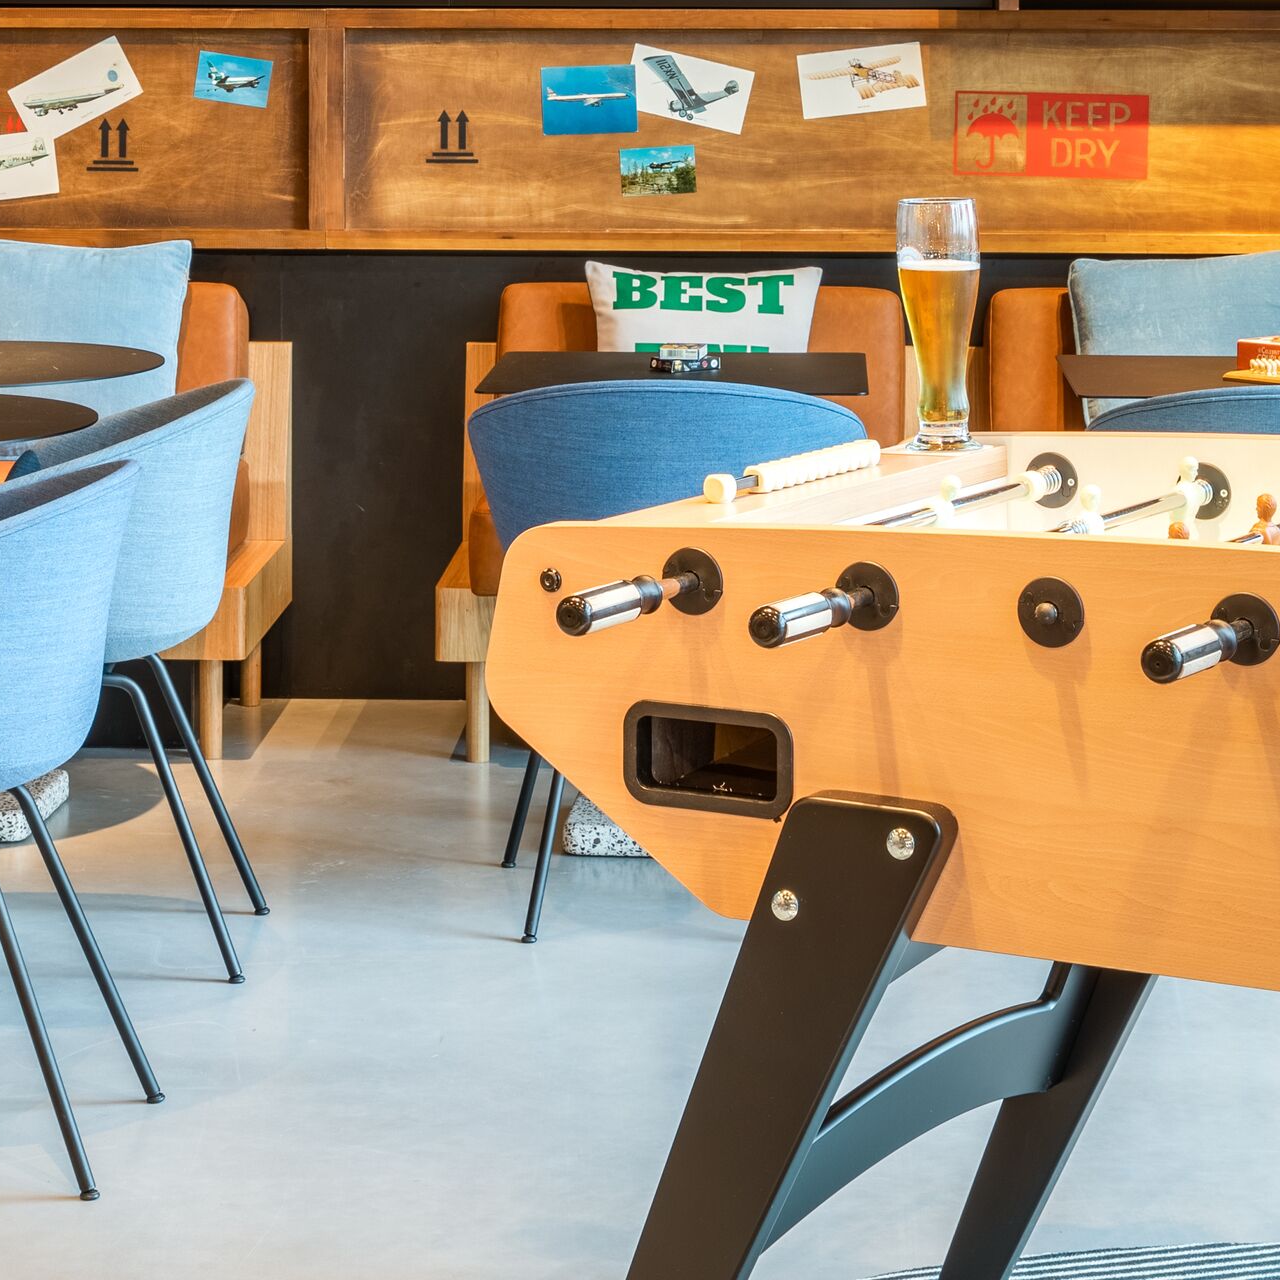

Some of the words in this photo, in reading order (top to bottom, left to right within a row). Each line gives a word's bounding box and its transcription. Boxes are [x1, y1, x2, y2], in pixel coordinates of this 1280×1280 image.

[1042, 101, 1131, 132] KEEP
[1050, 137, 1120, 168] DRY
[612, 271, 795, 315] BEST
